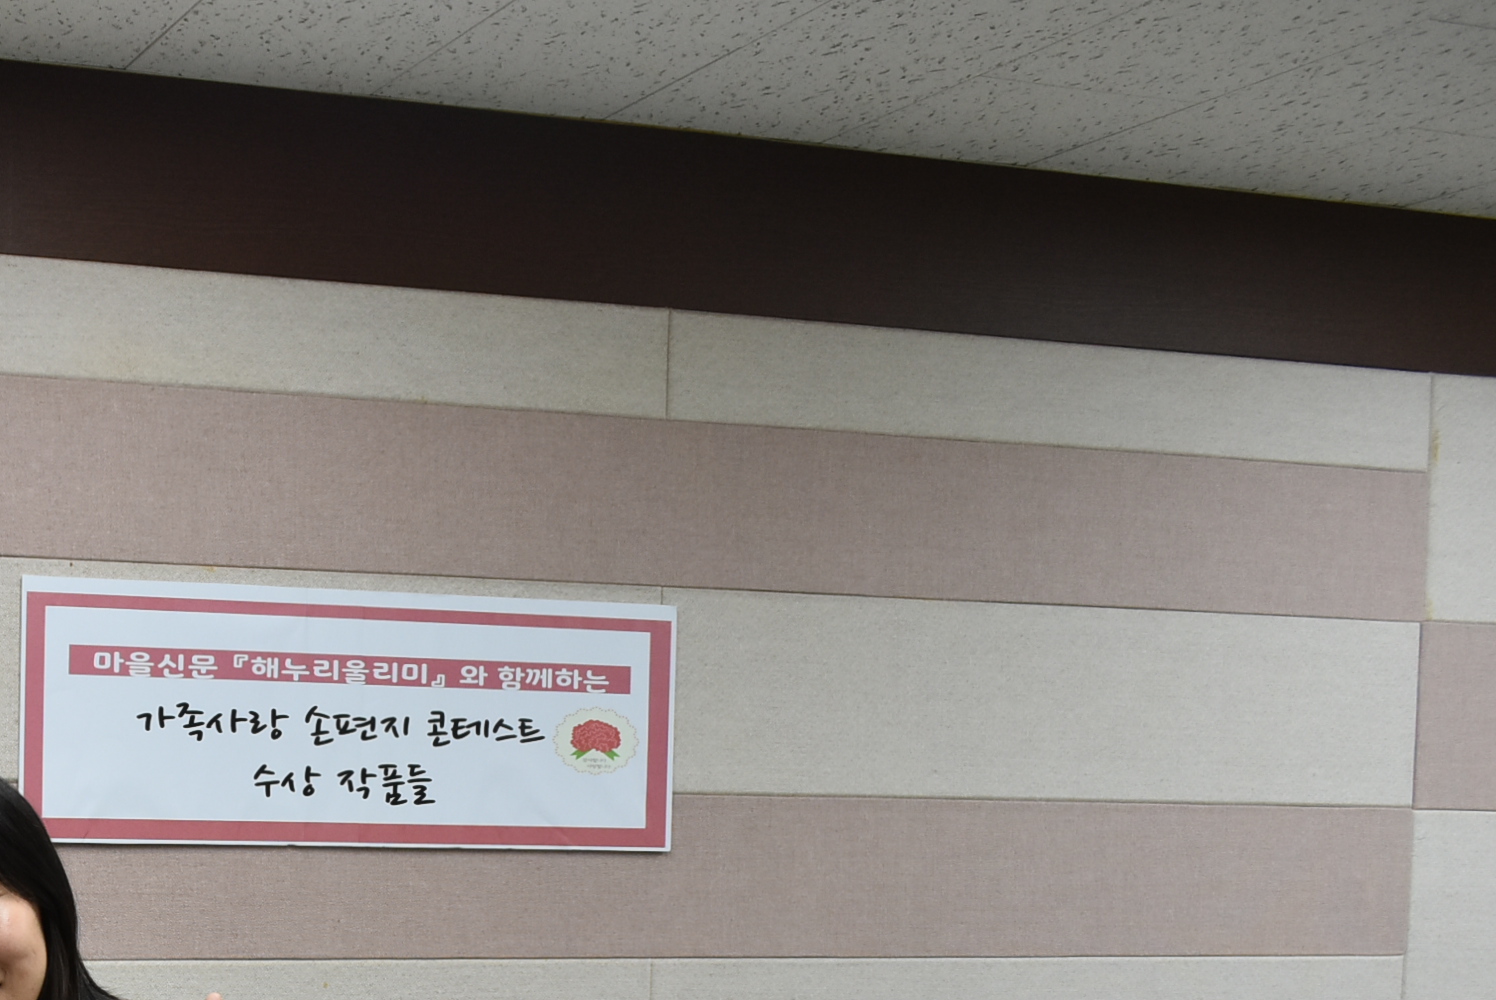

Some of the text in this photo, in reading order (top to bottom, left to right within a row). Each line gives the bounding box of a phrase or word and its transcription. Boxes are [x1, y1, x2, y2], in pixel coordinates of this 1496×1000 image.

[92, 650, 218, 680] 마을신문
[459, 665, 488, 688] 와
[497, 666, 610, 694] 함께하는
[136, 702, 546, 747] 가족사랑 손편지 콘테스트
[253, 763, 436, 806] 수상 작품들
